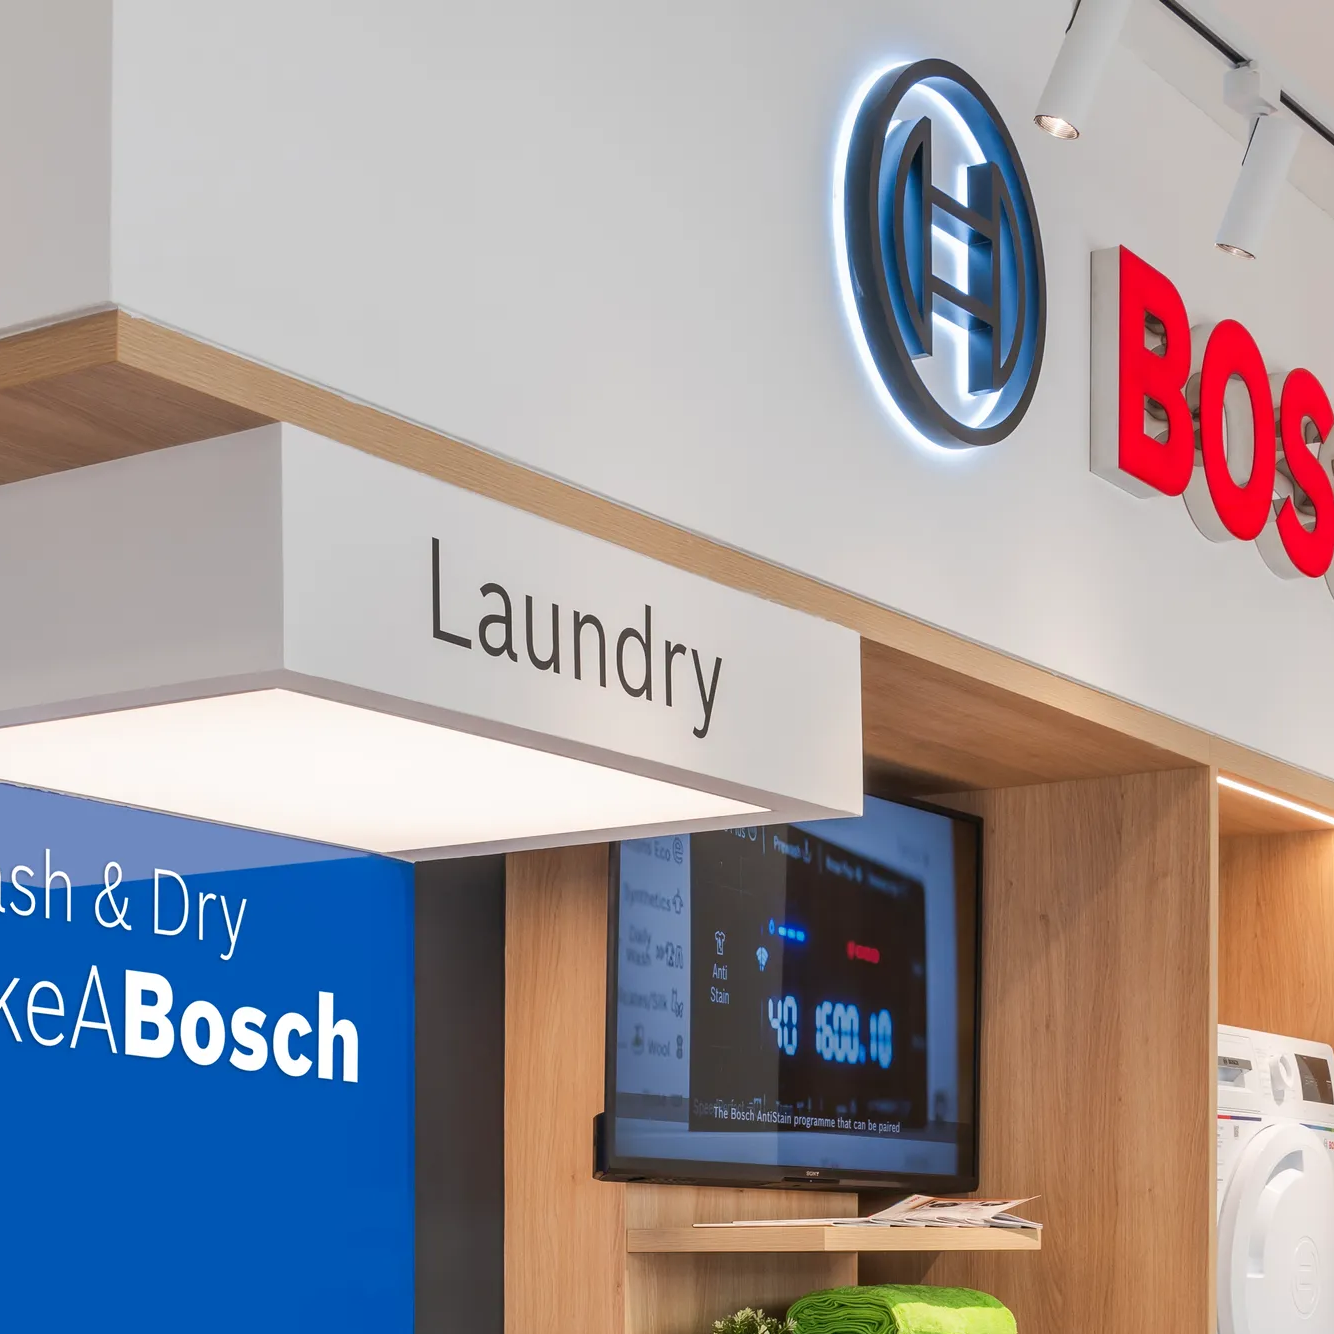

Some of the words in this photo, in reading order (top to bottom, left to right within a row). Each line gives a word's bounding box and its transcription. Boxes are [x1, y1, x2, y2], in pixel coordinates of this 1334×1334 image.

[431, 536, 723, 739] Laundry
[93, 861, 132, 931] &
[153, 867, 247, 960] Dry
[713, 963, 728, 981] Anti
[710, 986, 730, 1005] Stain
[768, 995, 798, 1056] 40
[713, 1106, 729, 1119] The
[730, 1107, 755, 1122] Bosch
[756, 1110, 792, 1124] AntiStain
[794, 1115, 836, 1128] programme
[837, 1117, 852, 1130] that
[853, 1119, 866, 1131] can
[867, 1120, 877, 1131] be
[878, 1122, 901, 1134] paired
